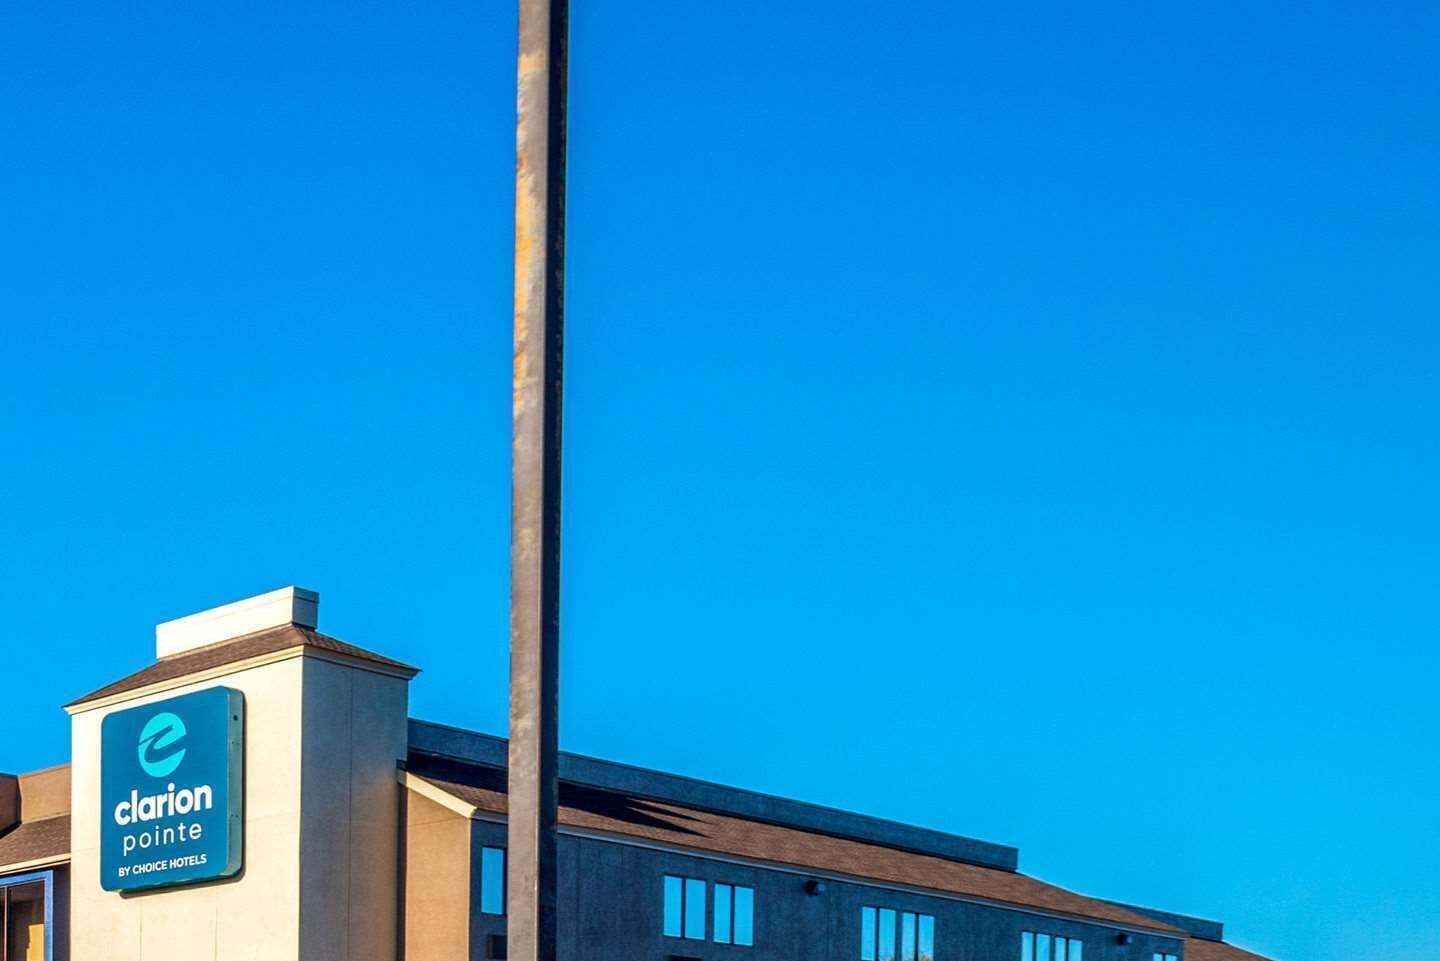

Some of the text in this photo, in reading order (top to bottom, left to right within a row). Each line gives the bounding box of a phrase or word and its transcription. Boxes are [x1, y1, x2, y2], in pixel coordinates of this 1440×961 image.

[114, 783, 213, 826] clarion
[123, 822, 203, 857] pointe
[118, 854, 208, 878] BY CHOICE HOTELS
